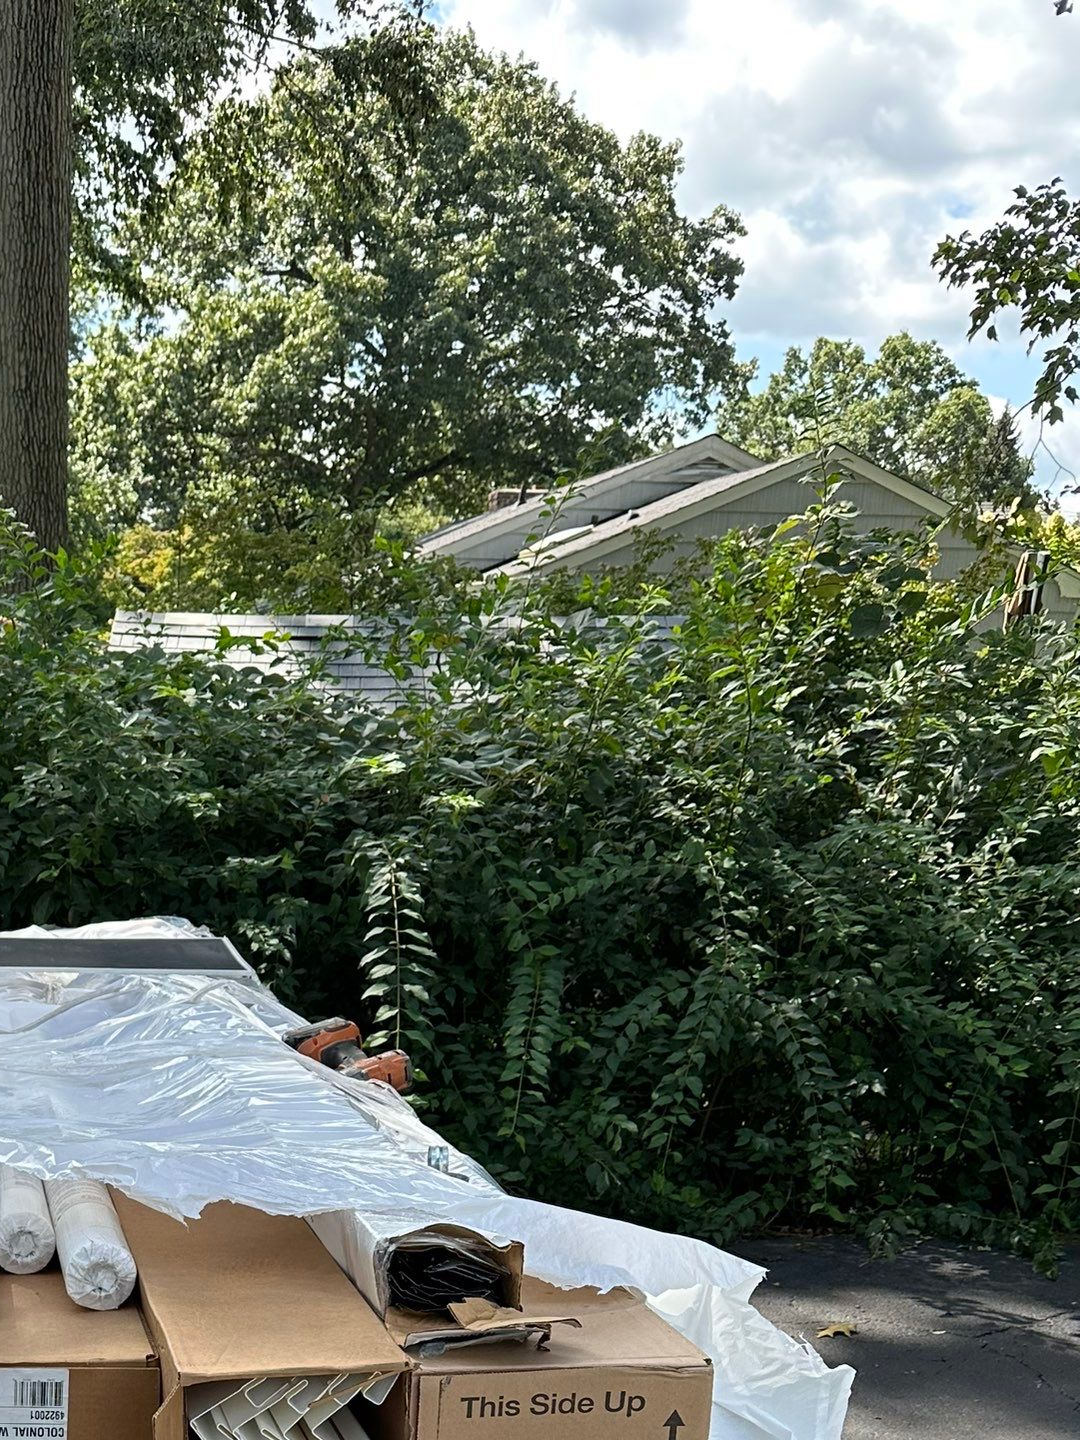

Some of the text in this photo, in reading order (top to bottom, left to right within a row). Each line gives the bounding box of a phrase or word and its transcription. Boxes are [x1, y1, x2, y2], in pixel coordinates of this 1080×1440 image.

[461, 1391, 646, 1418] This Side Up
[30, 1410, 64, 1420] 4922001
[13, 1426, 64, 1437] COLONIAL
